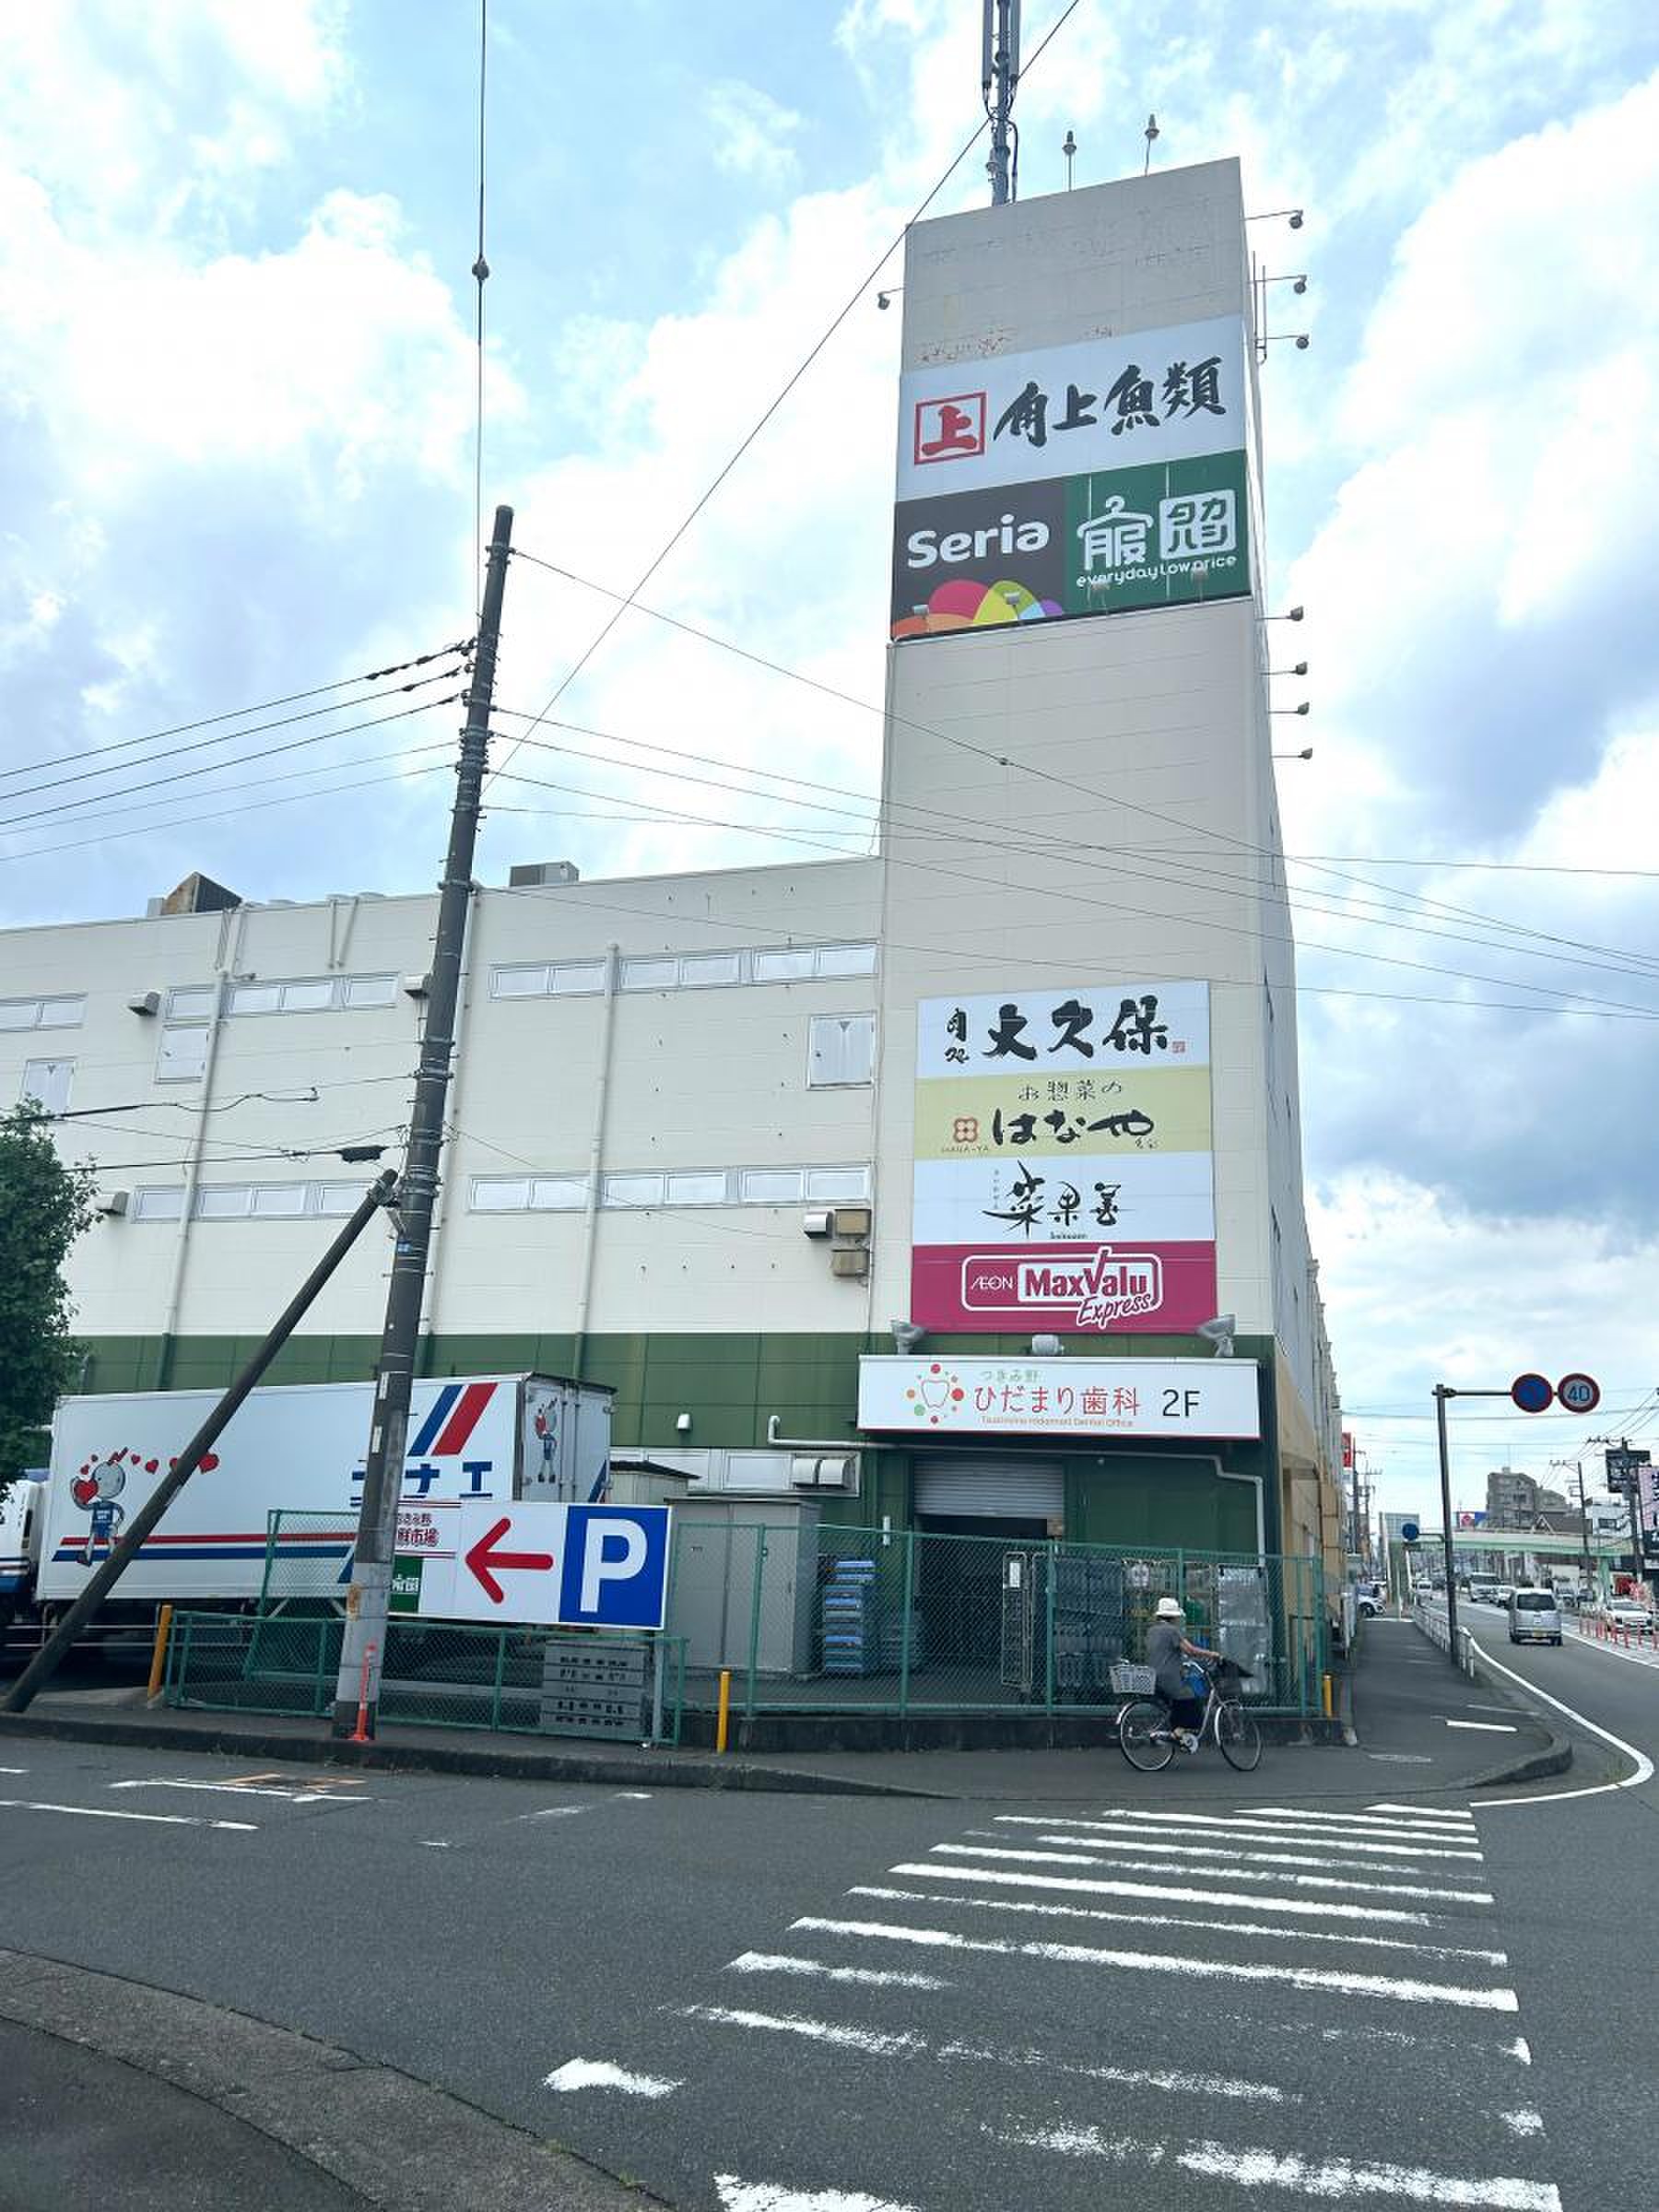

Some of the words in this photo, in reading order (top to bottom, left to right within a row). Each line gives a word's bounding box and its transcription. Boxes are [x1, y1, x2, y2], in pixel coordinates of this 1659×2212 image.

[918, 402, 982, 459] 上
[993, 356, 1227, 447] 角上魚類
[907, 512, 1050, 568] Seria
[982, 995, 1169, 1061] 大久保
[1018, 1079, 1122, 1101] お惣菜の
[992, 1108, 1155, 1146] はなや
[1025, 1251, 1148, 1298] MaxValu
[1078, 1294, 1151, 1326] Express
[974, 1385, 1139, 1417] ひだまり歯科
[1162, 1389, 1200, 1418] 2F
[1567, 1385, 1590, 1402] 40
[581, 1519, 648, 1613] P
